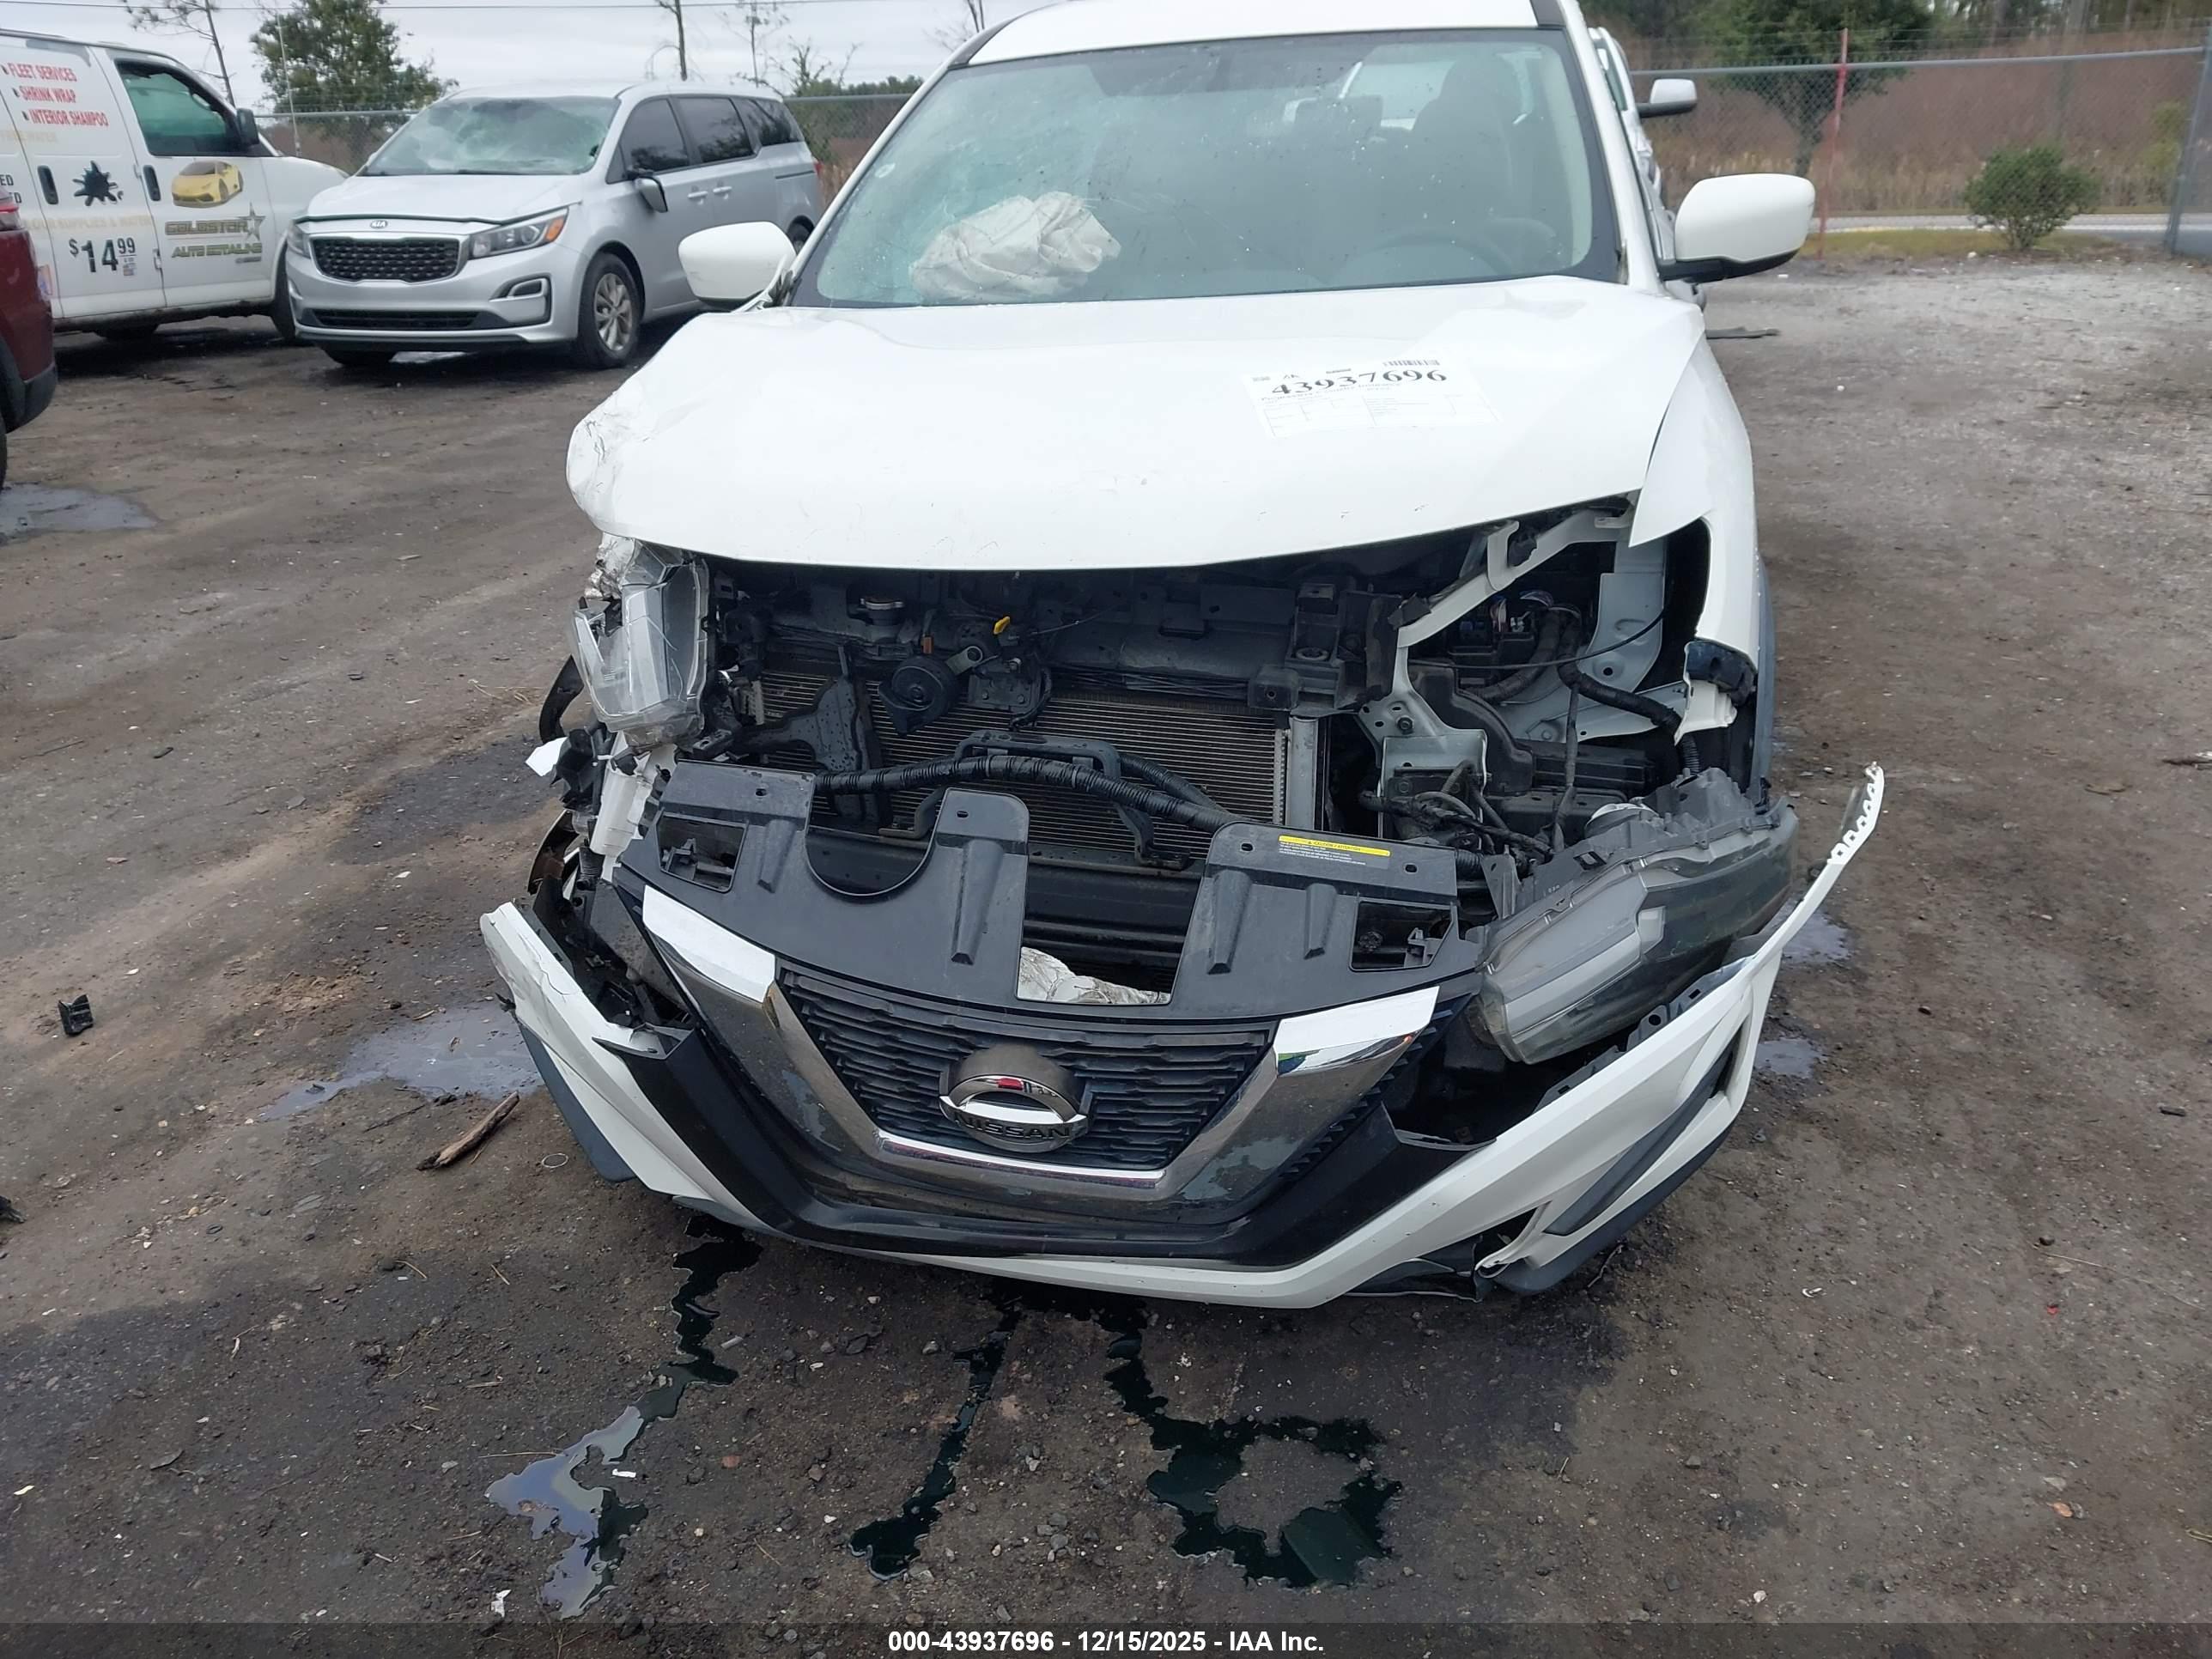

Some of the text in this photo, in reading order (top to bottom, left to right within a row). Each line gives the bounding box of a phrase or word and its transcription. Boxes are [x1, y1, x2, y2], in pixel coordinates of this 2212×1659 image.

[8, 63, 77, 82] FLEET SERVICES
[19, 86, 76, 103] SHRINK WRAP
[28, 109, 109, 126] INTERIOR SHAMPOO
[1272, 368, 1448, 394] 43937696
[953, 1110, 1071, 1139] NISSAN
